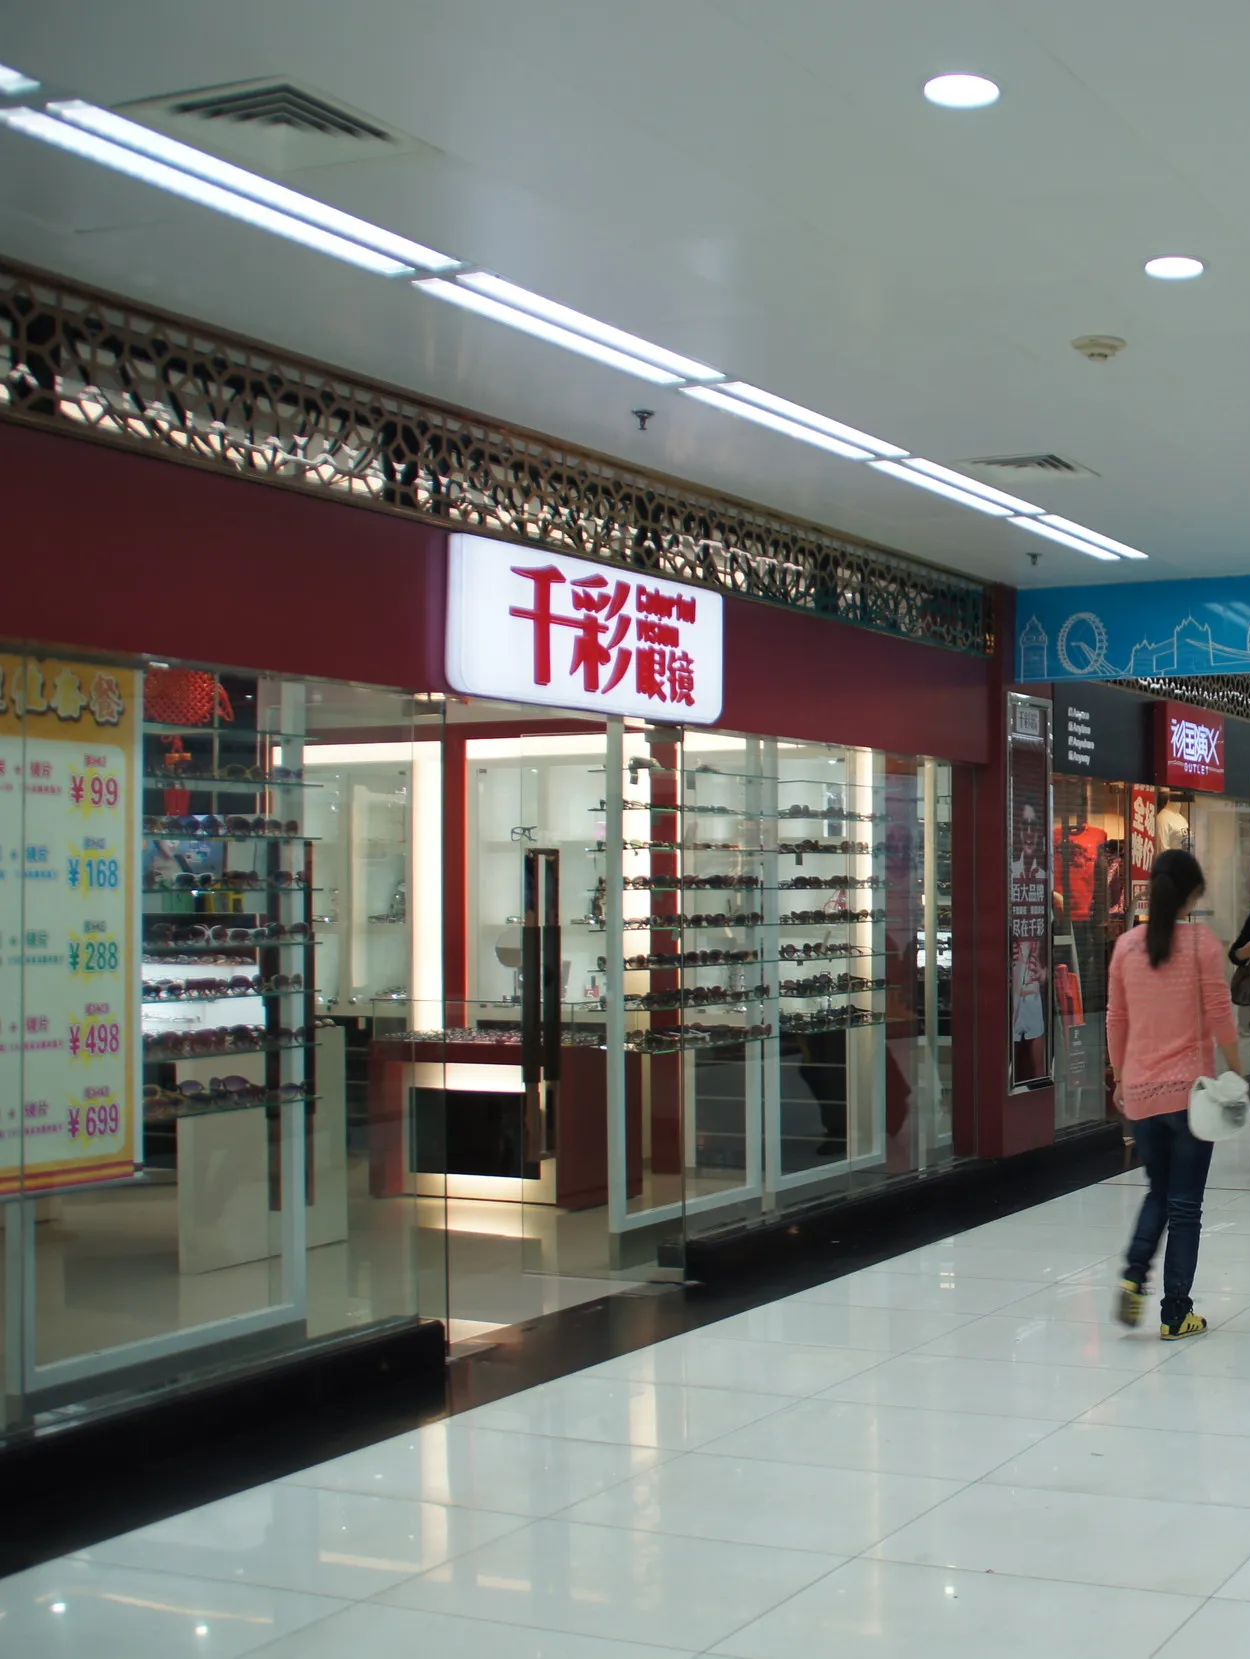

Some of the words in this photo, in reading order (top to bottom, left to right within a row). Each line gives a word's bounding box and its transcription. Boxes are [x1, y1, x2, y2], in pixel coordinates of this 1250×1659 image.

[636, 583, 697, 625] Colorful
[509, 564, 632, 694] 千彩
[636, 646, 696, 707] 眼镜
[1183, 762, 1209, 775] OUTLET
[71, 775, 119, 806] ¥99
[67, 858, 119, 889] ¥168
[68, 940, 119, 972] ¥288
[69, 1022, 121, 1056] ¥498
[67, 1101, 120, 1138] ¥699
